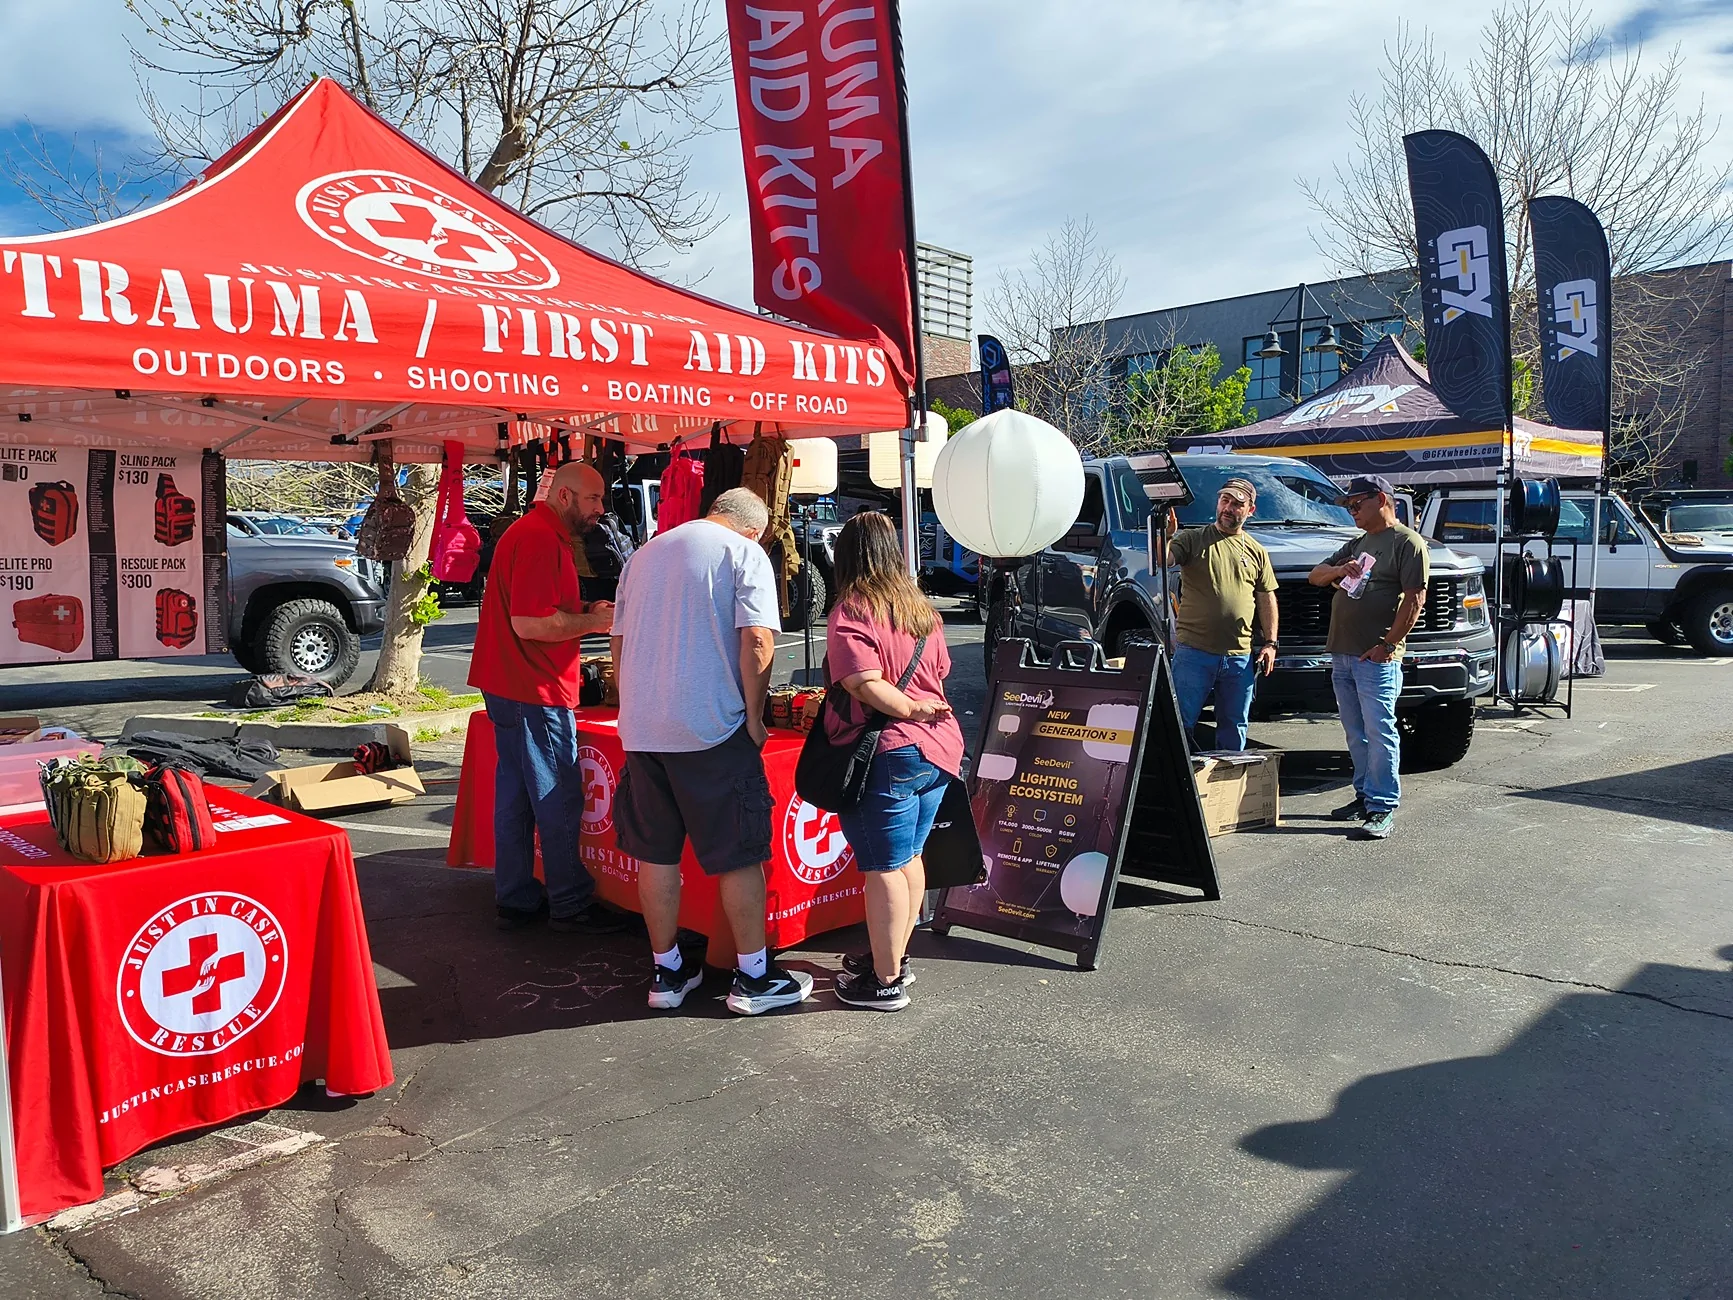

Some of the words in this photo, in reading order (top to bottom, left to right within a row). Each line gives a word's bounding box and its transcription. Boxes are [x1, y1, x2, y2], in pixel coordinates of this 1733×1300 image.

[746, 4, 810, 121] AID
[818, 0, 883, 190] UMA
[312, 178, 365, 219] JUST
[371, 177, 419, 196] IN
[432, 195, 519, 247] CASE
[755, 145, 822, 300] KITS
[378, 251, 545, 285] RESCUE
[1437, 225, 1493, 326] GFX
[1428, 239, 1440, 324] WHEELS
[3, 249, 379, 345] TRAUMA
[477, 303, 654, 368] FIRST
[683, 329, 766, 377] AID
[791, 340, 886, 388] KITS
[1545, 288, 1556, 360] WHEELS
[132, 346, 346, 385] OUTDOORS
[406, 366, 560, 397] SHOOTING
[608, 380, 711, 407] BOATING
[750, 391, 787, 411] OFF
[796, 395, 848, 416] ROAD
[28, 449, 57, 463] PACK
[120, 455, 150, 467] SLING
[151, 455, 177, 467] PACK
[118, 470, 149, 485] $130
[31, 558, 53, 570] PRO
[121, 558, 159, 570] RESCUE
[161, 558, 187, 570] PACK
[0, 575, 34, 590] $190
[121, 574, 152, 589] $300
[1003, 691, 1043, 704] SeeDevil
[1047, 710, 1071, 720] NEW
[1039, 725, 1108, 740] GENERATION
[1109, 732, 1117, 741] 3
[586, 749, 595, 759] IN
[598, 756, 614, 787] CASE
[1020, 772, 1078, 790] LIGHTING
[1009, 785, 1083, 806] ECOSYSTEM
[579, 844, 615, 864] IRST
[997, 852, 1017, 861] REMOTE
[601, 864, 629, 882] BOATING
[796, 851, 850, 880] RESCUE
[1035, 860, 1060, 869] LIFETIME
[998, 905, 1035, 919] SeeDevil.com
[128, 909, 177, 971] JUST
[190, 897, 219, 916] IN
[230, 899, 280, 947] CASE
[876, 985, 901, 998] HOKA
[148, 1002, 262, 1052] RESCUE
